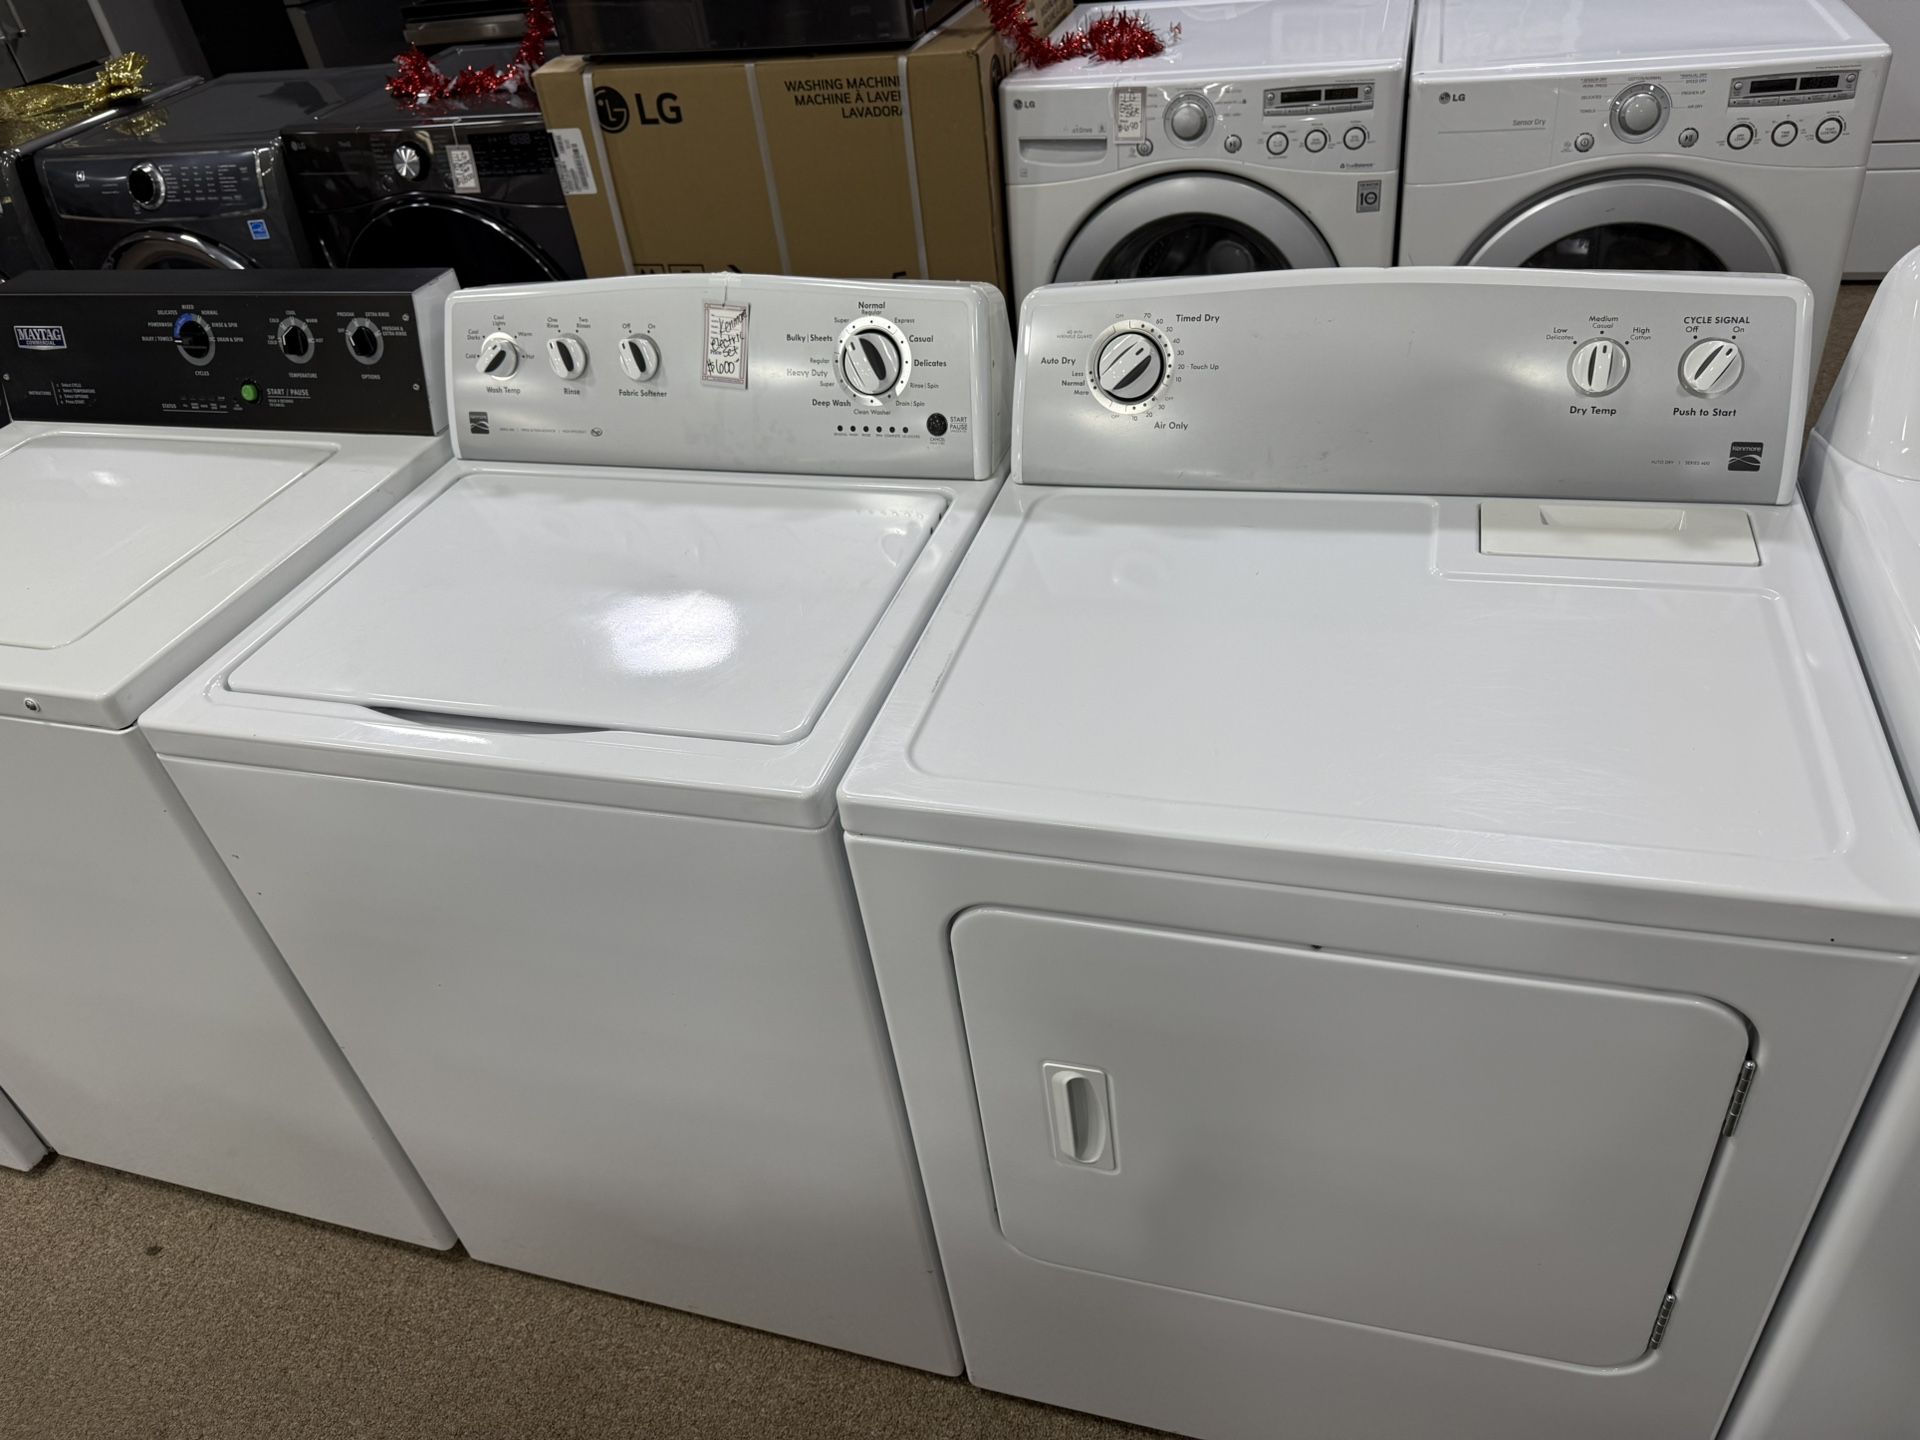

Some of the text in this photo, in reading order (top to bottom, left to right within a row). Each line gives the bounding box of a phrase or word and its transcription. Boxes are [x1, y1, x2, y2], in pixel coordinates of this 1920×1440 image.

[784, 78, 843, 92] WASHING
[794, 93, 851, 106] MACHINE
[855, 90, 865, 103] À
[1452, 93, 1466, 102] LG
[634, 92, 683, 125] LG
[1024, 100, 1036, 109] LG
[1176, 314, 1220, 323] Timed Dry
[1684, 316, 1750, 324] CYCLE SIGNAL
[16, 328, 62, 340] MAYTAG
[1632, 327, 1650, 335] High
[786, 334, 833, 343] Bulky Sheets
[908, 335, 934, 343] Casual
[1061, 357, 1076, 366] Dry
[786, 368, 828, 378] Heavy Duty
[486, 386, 521, 396] Wash Temp
[618, 389, 667, 398] Fabric Softener
[812, 399, 830, 408] Deep
[1570, 406, 1617, 416] Dry Temp
[1673, 408, 1696, 416] Push
[1712, 408, 1737, 417] Start
[1154, 421, 1188, 431] Air Only
